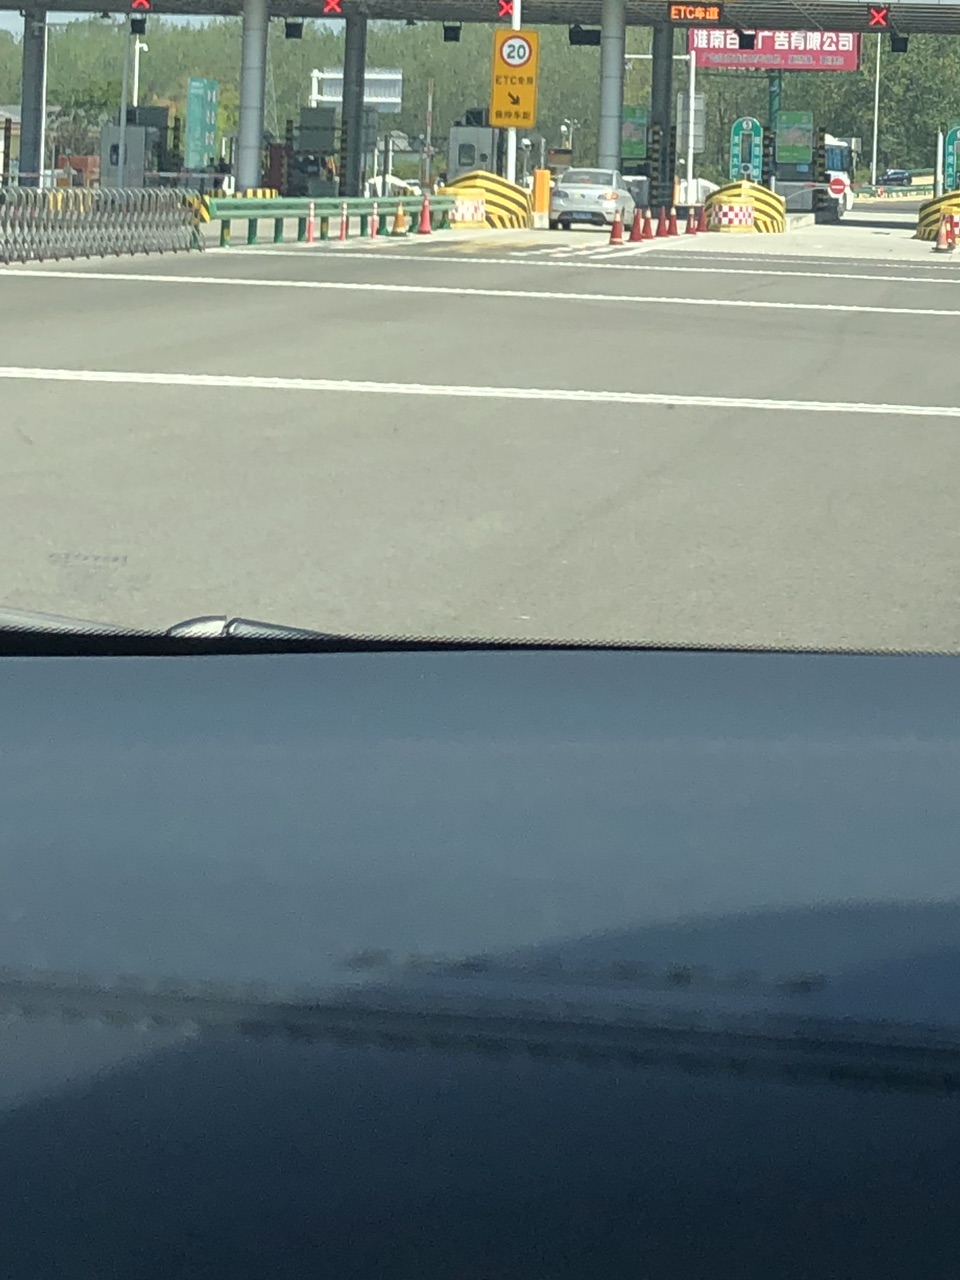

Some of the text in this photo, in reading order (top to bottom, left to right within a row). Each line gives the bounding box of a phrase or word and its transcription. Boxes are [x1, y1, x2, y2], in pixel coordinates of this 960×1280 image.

[671, 6, 720, 20] ETC车道
[693, 29, 854, 51] 淮南百广告有限公司
[507, 44, 526, 60] 20
